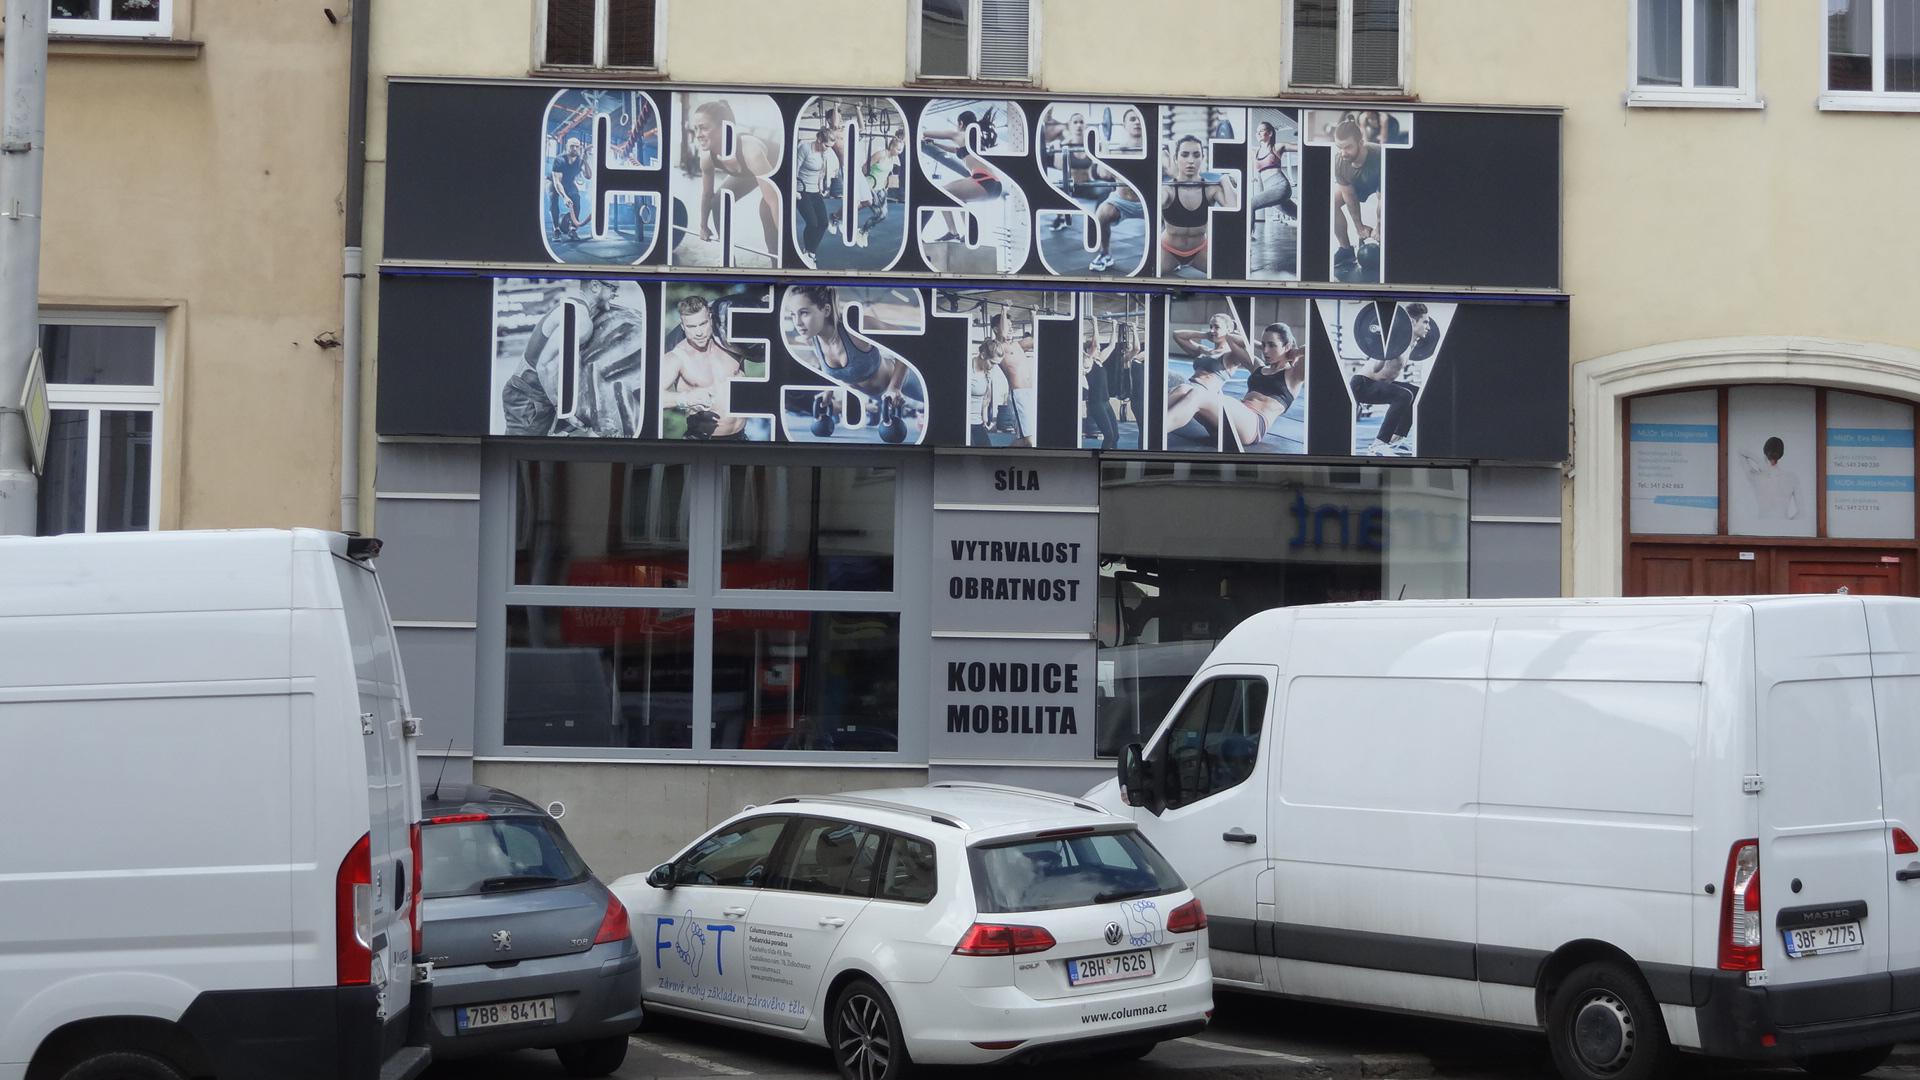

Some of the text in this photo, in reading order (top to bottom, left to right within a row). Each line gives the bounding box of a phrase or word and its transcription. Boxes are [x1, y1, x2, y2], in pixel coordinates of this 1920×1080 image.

[540, 88, 1414, 284] CROSSFIT
[489, 277, 1458, 458] DESTINY
[994, 466, 1040, 491] SÍLA
[951, 539, 1080, 564] VYTRVALOST
[949, 576, 1080, 602] OBRATNOST
[947, 661, 1078, 694] KONDICE
[947, 704, 1078, 735] MOBILITA
[1802, 909, 1849, 921] MASTER
[1795, 930, 1816, 949] 3BF
[1826, 925, 1856, 945] 2775
[1080, 959, 1106, 978] 2BH
[1114, 954, 1147, 974] 7626
[687, 983, 705, 1001] nohy
[707, 988, 745, 1003] základem
[747, 994, 786, 1012] zdravého
[789, 1001, 805, 1016] těla
[470, 1007, 499, 1026] 7B8
[510, 1000, 547, 1020] 8411
[1081, 1004, 1168, 1024] www.columna.cz
